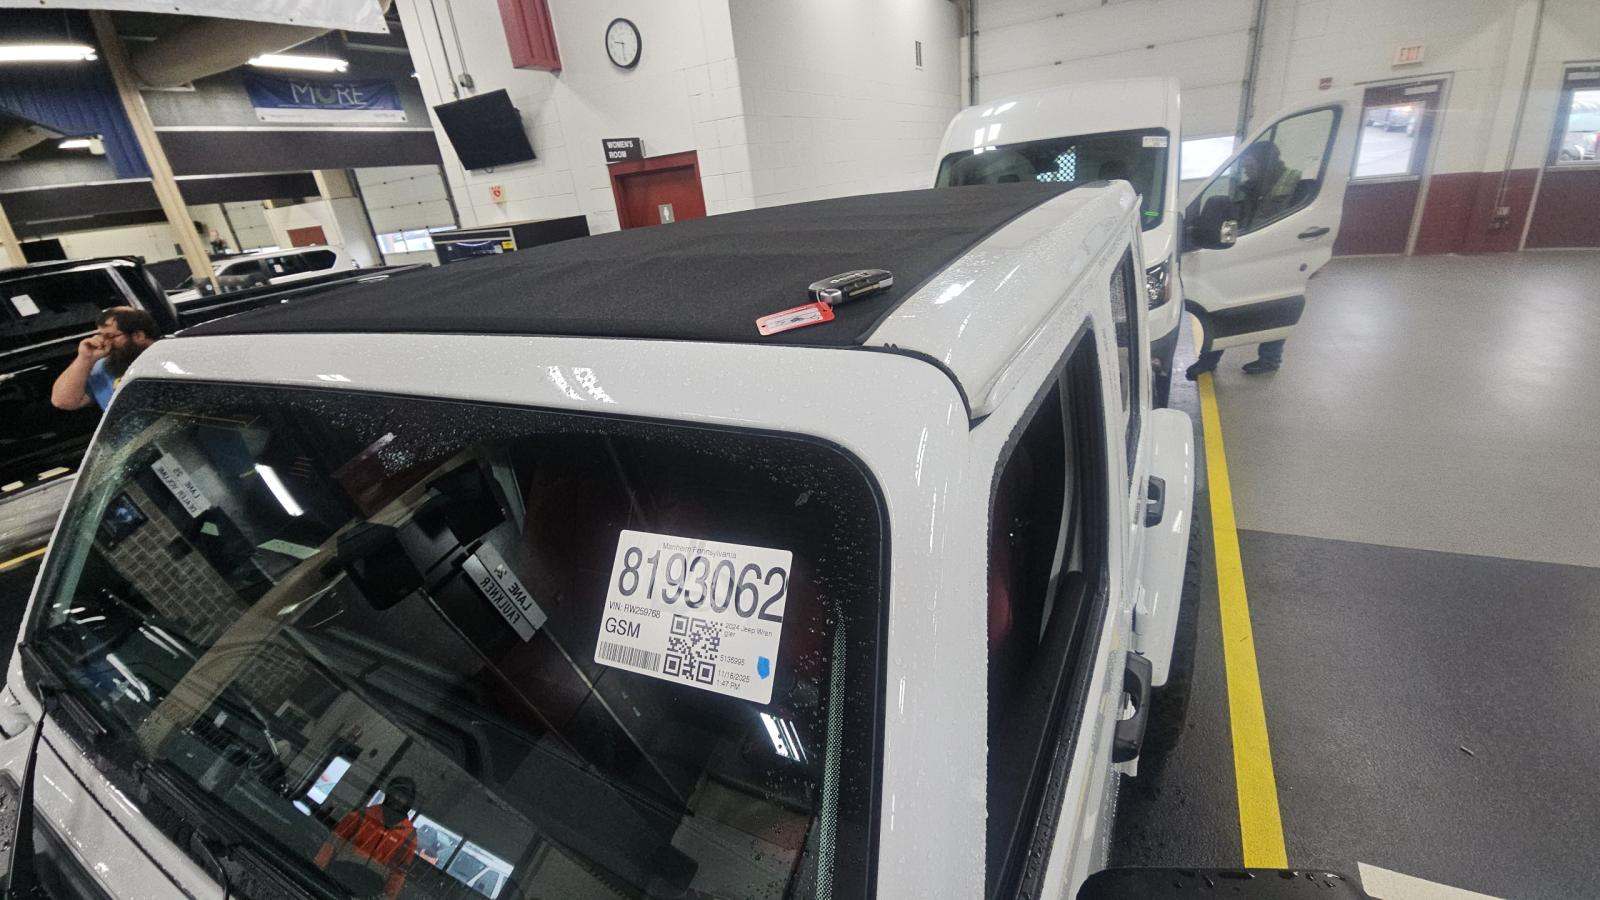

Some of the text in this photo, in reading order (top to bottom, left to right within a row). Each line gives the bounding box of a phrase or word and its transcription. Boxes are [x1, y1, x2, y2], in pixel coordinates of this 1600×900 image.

[290, 82, 368, 105] MORE
[608, 150, 627, 159] ROOM
[617, 546, 788, 624] 8193062
[609, 600, 623, 611] VIN:
[605, 617, 641, 639] GSM
